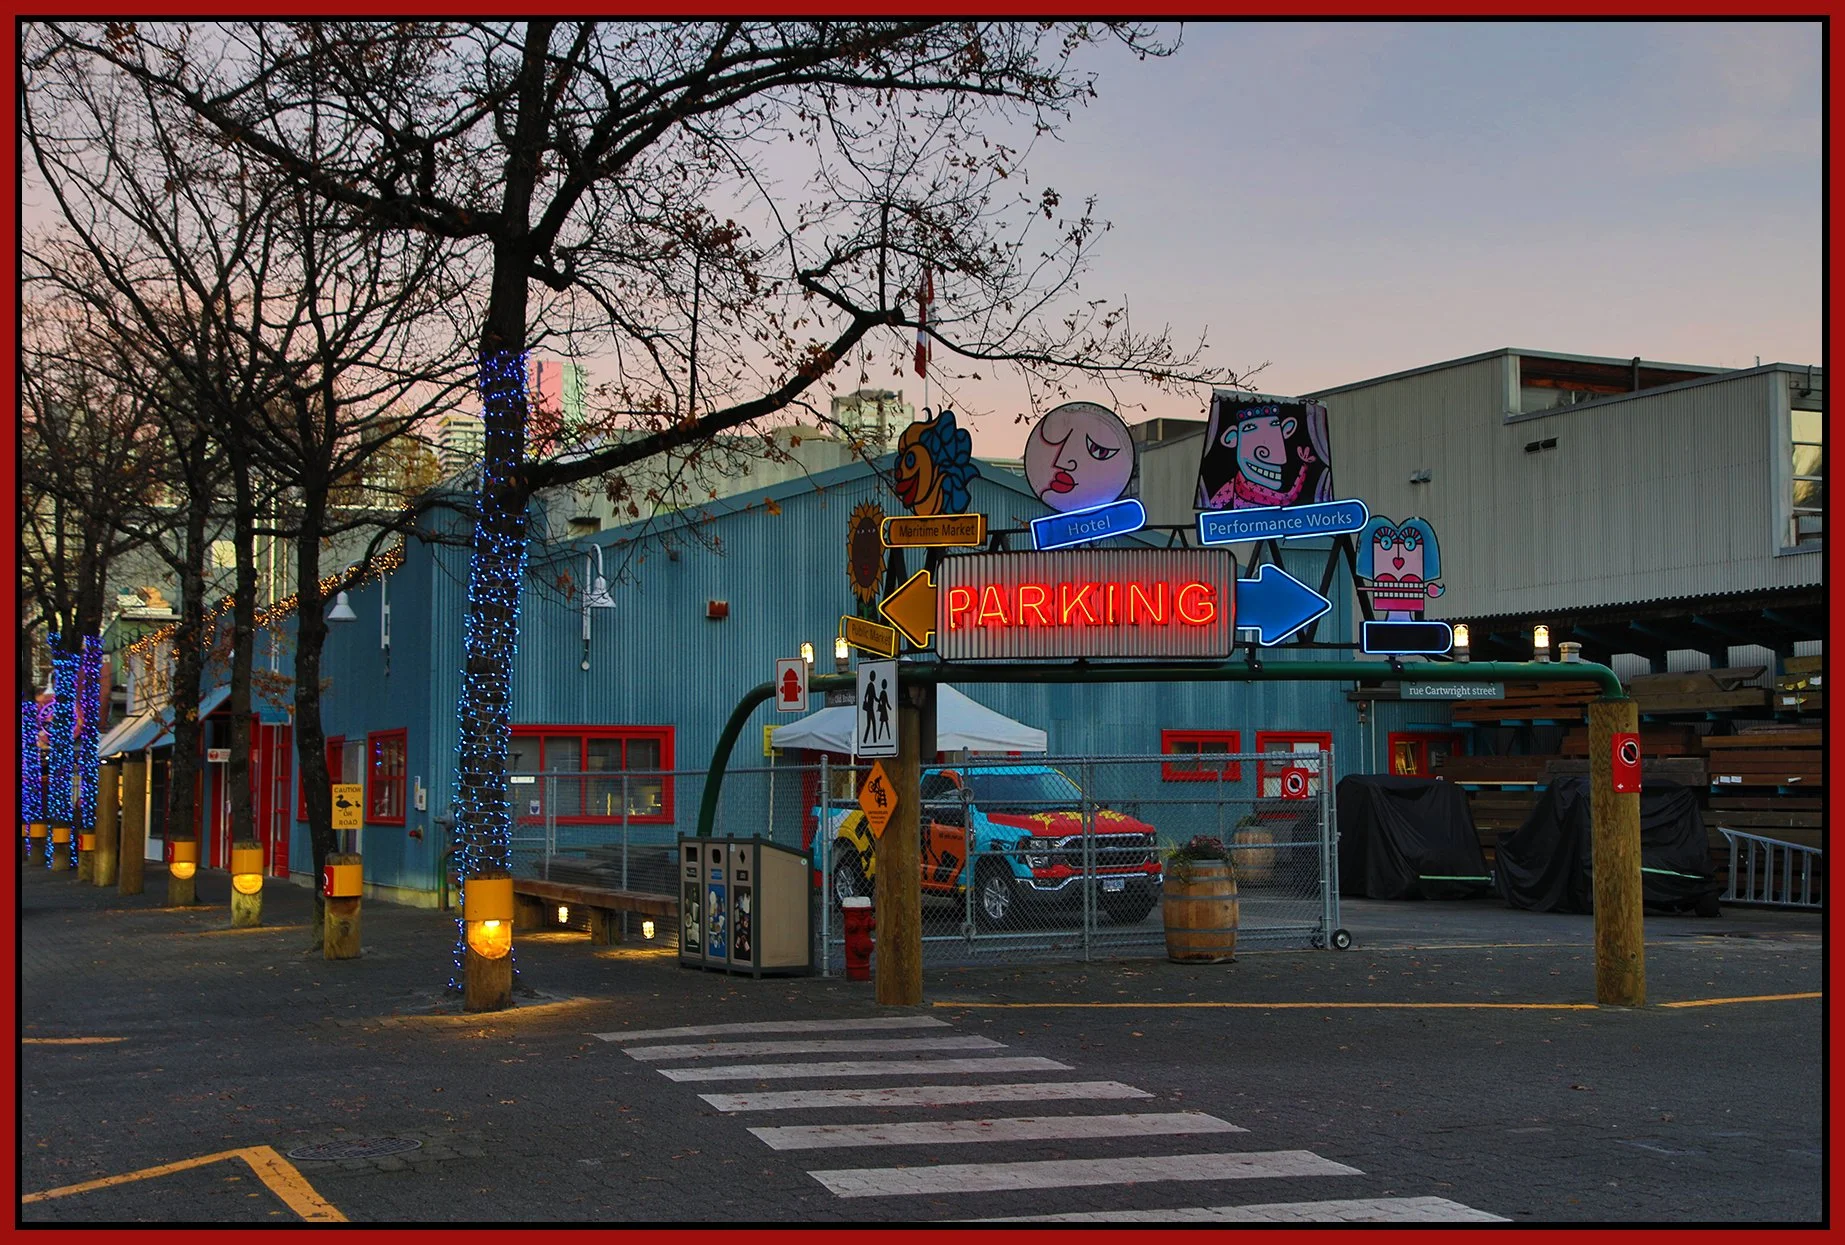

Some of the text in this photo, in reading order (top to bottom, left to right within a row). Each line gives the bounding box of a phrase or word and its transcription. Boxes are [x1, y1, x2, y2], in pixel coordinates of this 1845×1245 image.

[899, 524, 975, 537] Maritime Market
[1067, 515, 1111, 536] Hotel
[1209, 511, 1353, 536] Performance Works
[948, 581, 1218, 629] PARKING
[851, 623, 892, 646] Public Market
[1409, 685, 1496, 698] rue Cartwright street
